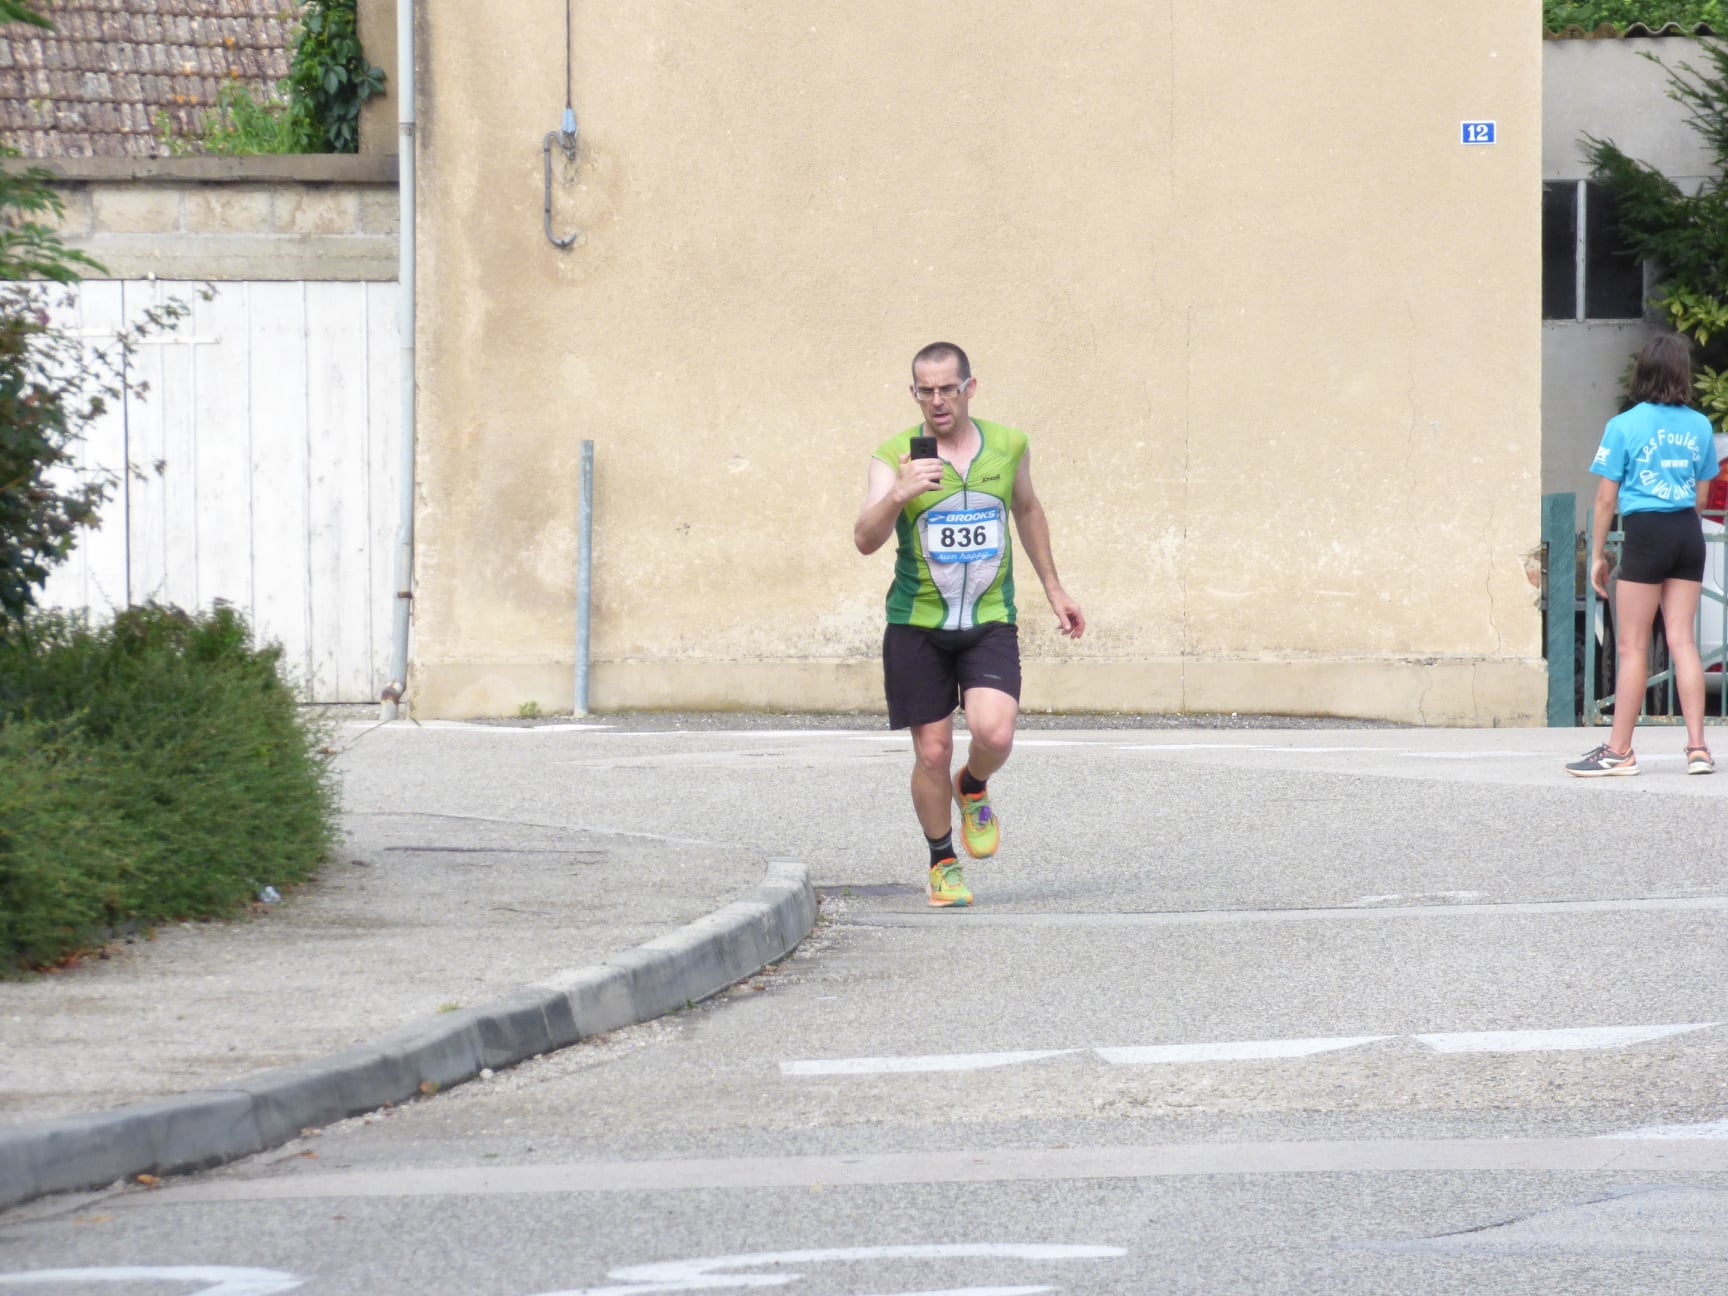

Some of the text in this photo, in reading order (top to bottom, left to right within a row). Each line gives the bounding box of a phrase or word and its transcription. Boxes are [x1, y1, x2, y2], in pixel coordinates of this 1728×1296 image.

[1467, 124, 1489, 141] 12
[1635, 437, 1658, 463] Les
[945, 510, 996, 522] BROOKS
[940, 525, 987, 548] 836
